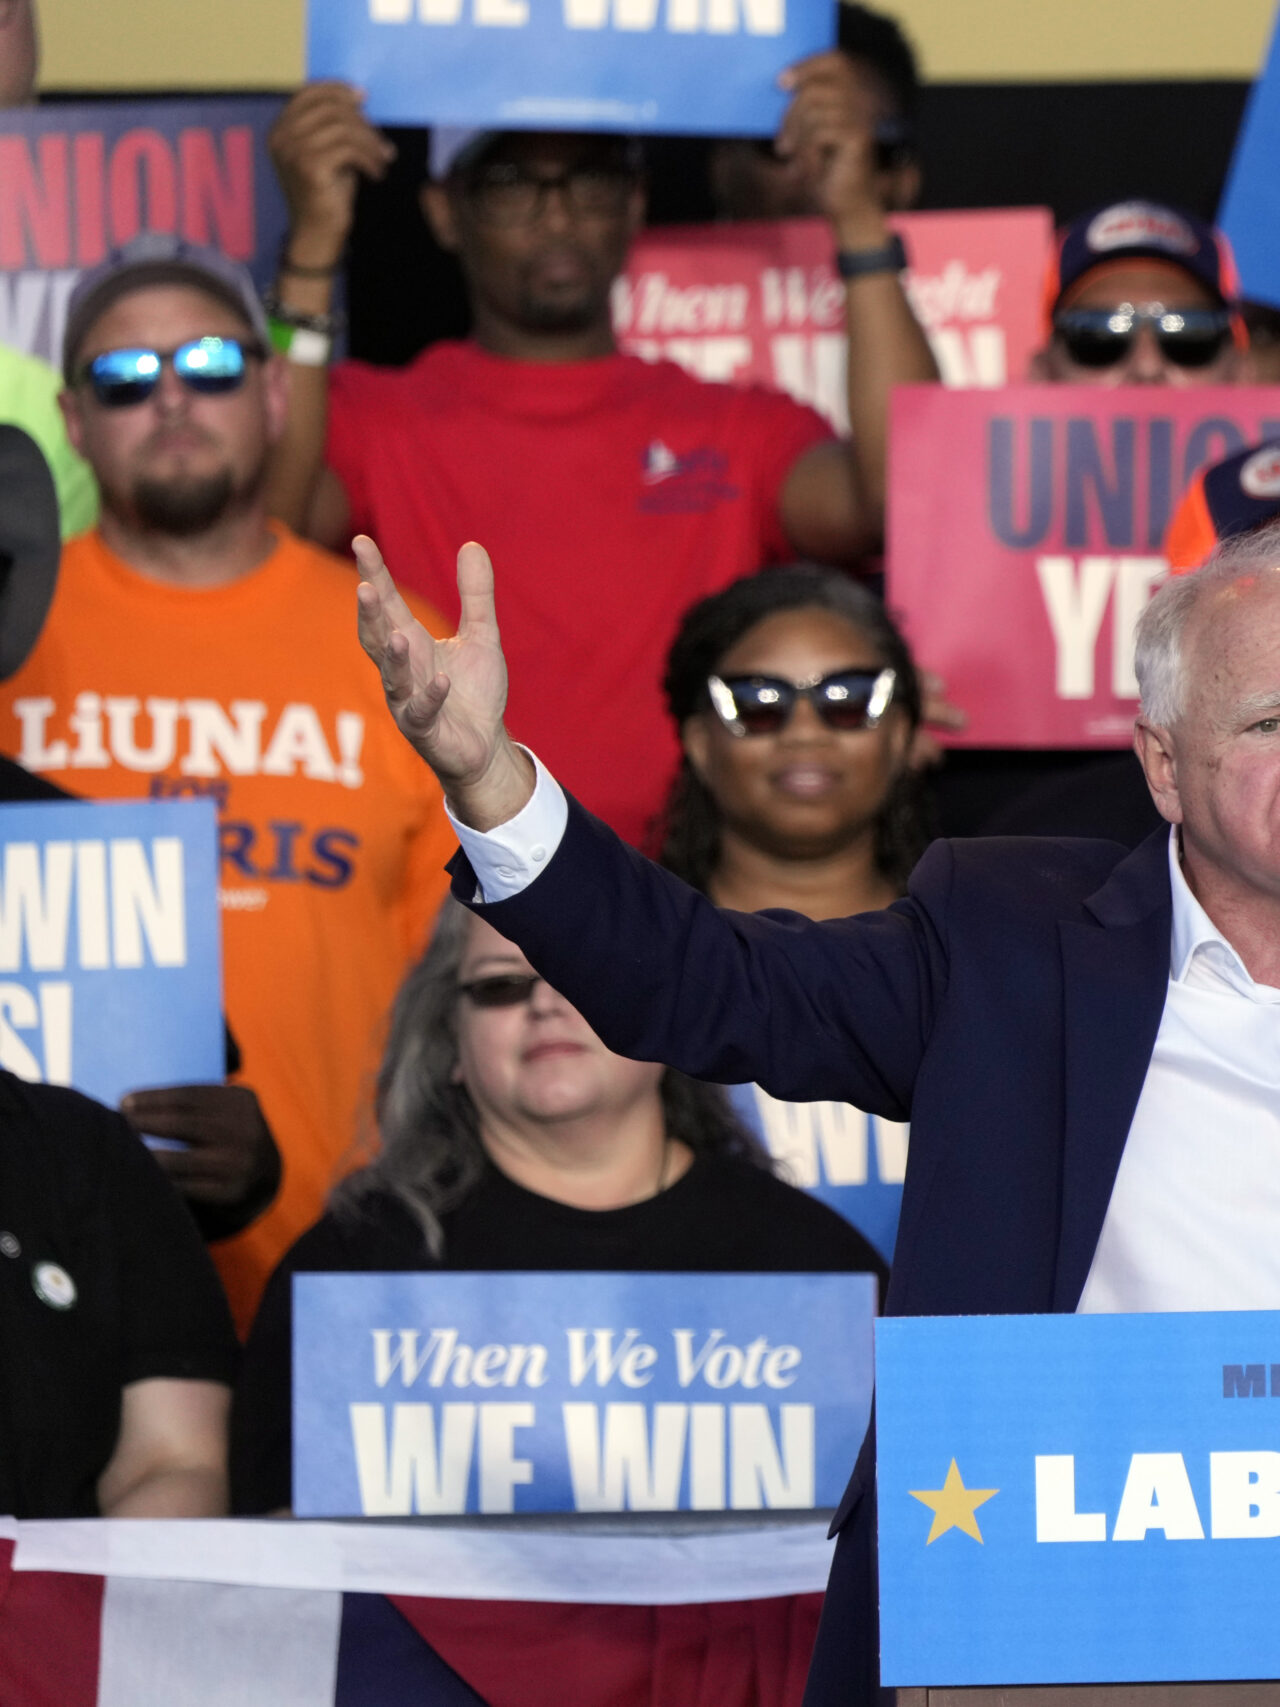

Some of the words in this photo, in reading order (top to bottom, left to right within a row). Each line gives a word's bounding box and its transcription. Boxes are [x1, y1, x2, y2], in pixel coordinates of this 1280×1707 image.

[1036, 555, 1170, 699] YE
[13, 692, 366, 789] LiUNA!
[0, 837, 187, 973] WIN
[370, 1328, 549, 1389] When
[566, 1328, 658, 1389] We
[672, 1328, 802, 1390] Vote
[562, 1401, 816, 1512] WIN
